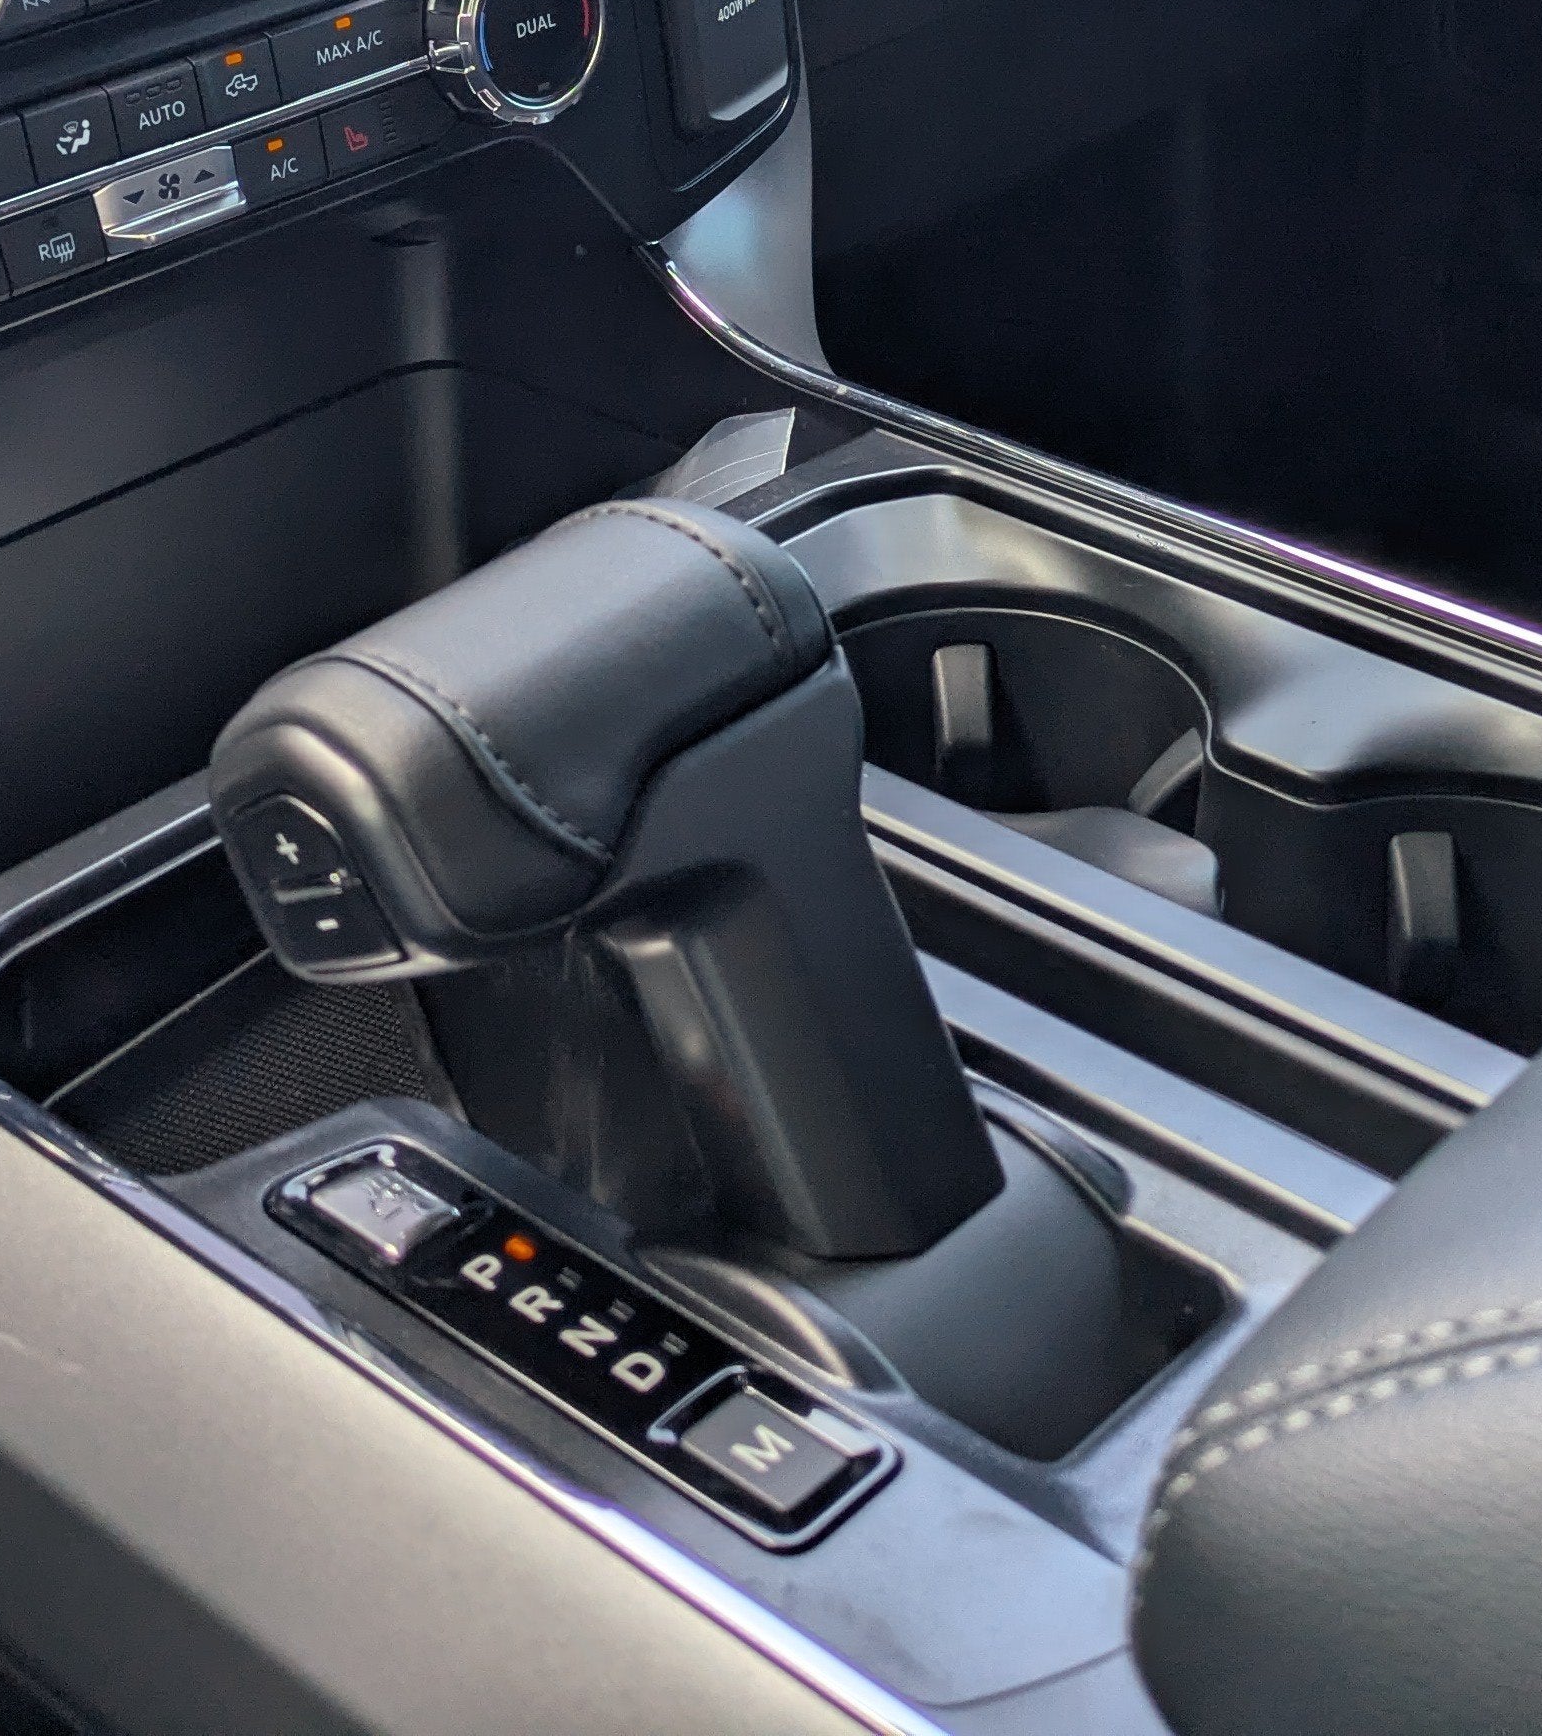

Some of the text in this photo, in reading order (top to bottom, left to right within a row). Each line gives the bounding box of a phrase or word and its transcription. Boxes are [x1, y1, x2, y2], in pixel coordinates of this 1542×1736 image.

[515, 13, 557, 40] DUAL
[316, 29, 384, 66] MAX A/C
[137, 100, 187, 131] AUTO
[269, 157, 299, 183] A/C
[38, 242, 51, 262] R
[461, 1252, 665, 1394] P R N D
[729, 1424, 796, 1473] M
